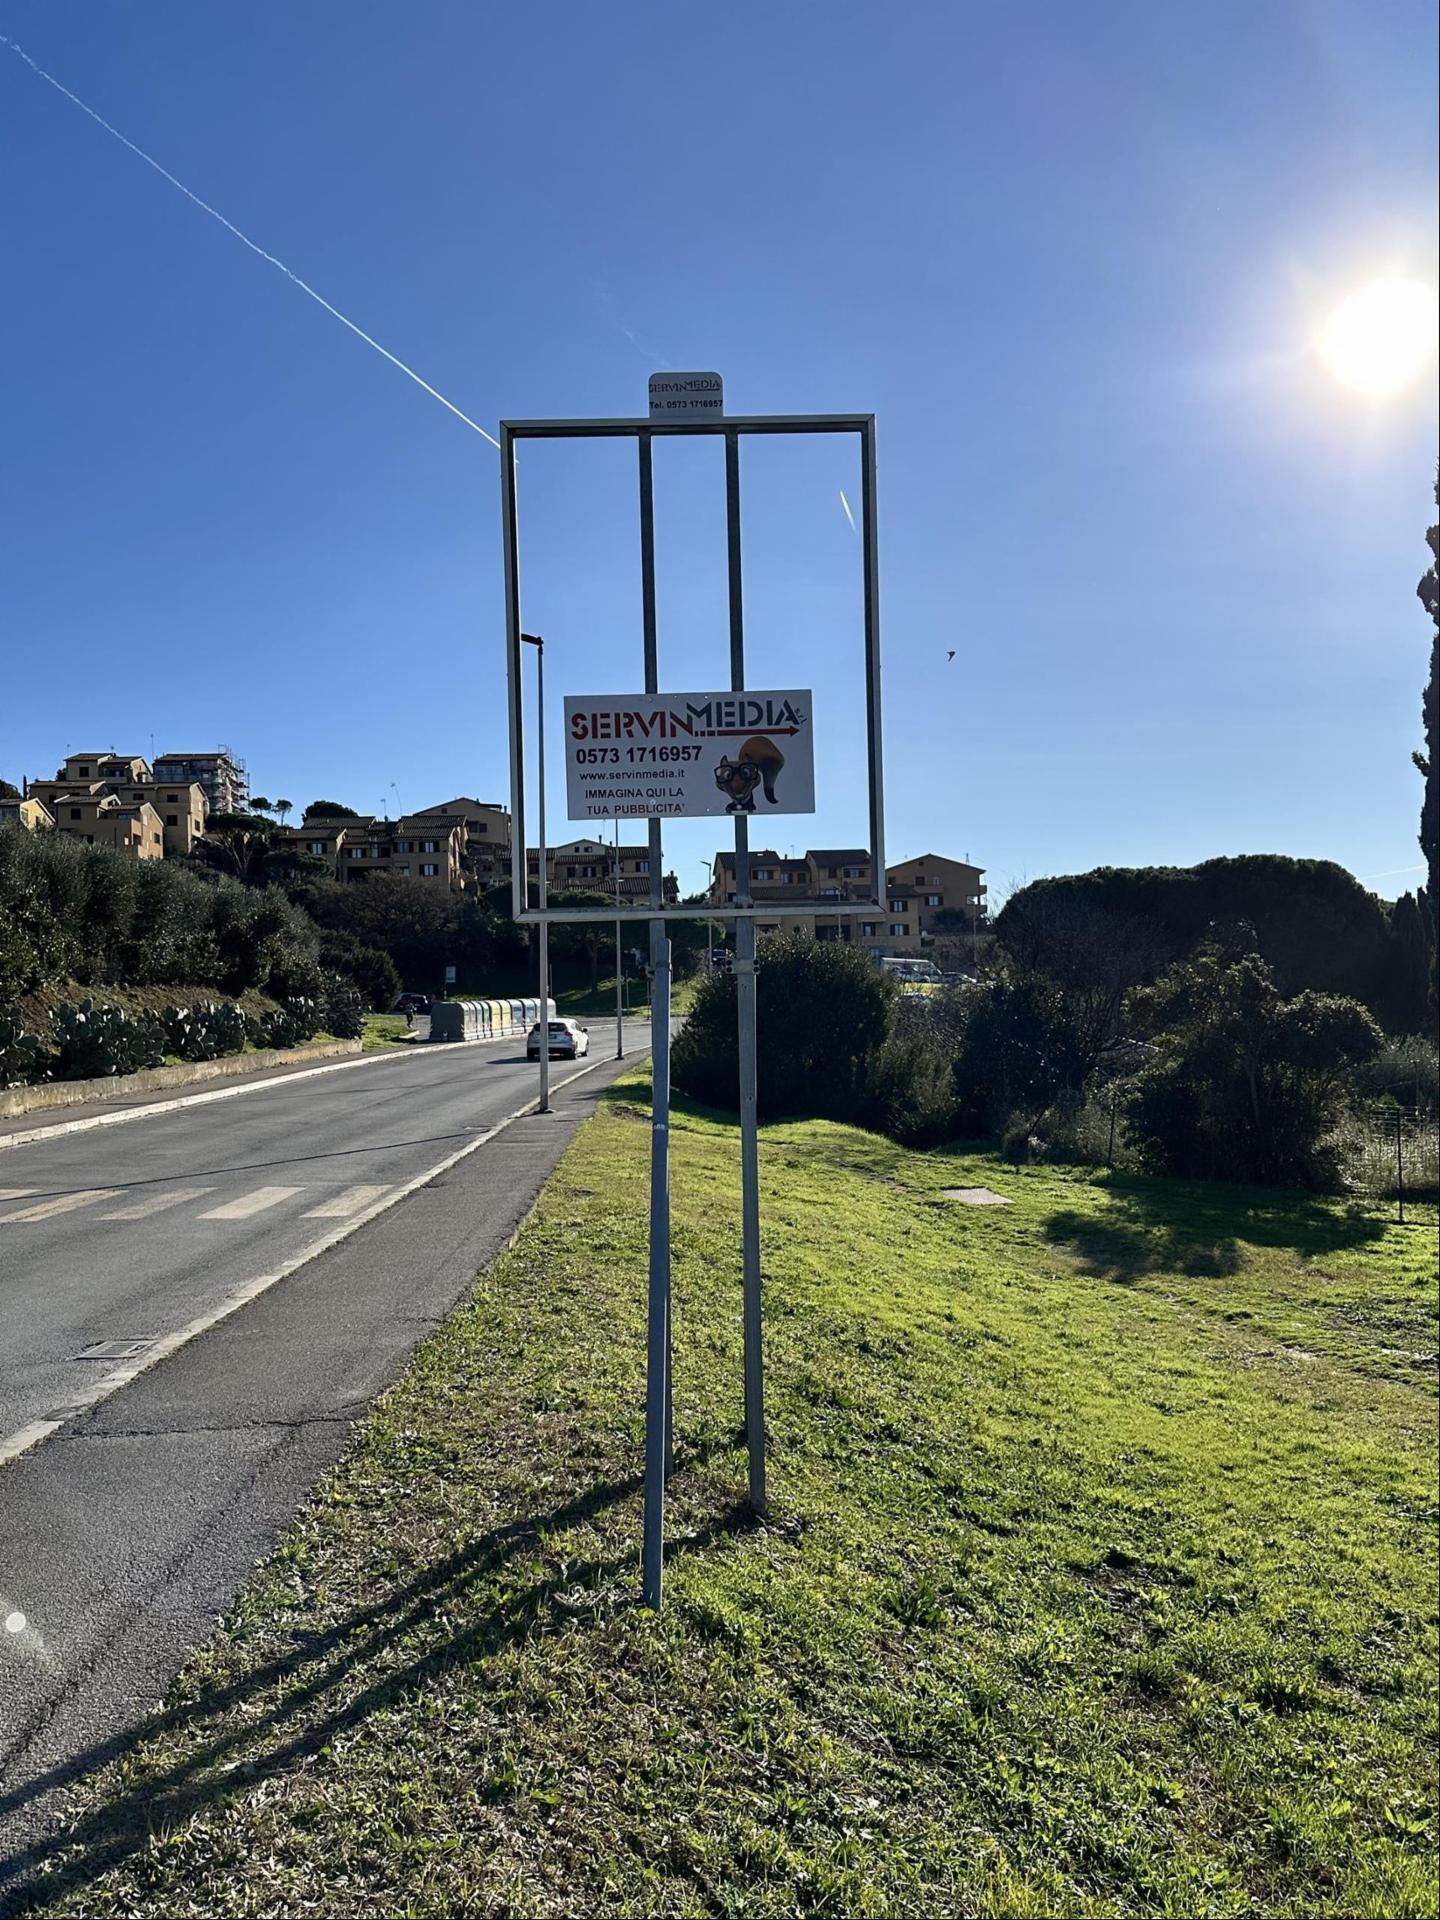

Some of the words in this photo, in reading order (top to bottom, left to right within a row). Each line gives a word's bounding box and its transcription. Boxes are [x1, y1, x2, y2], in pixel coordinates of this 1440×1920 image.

[650, 401, 664, 409] Tel.
[667, 400, 687, 409] 0573
[689, 399, 723, 408] 1716957
[576, 748, 620, 764] 0573
[626, 745, 703, 763] 1716957
[580, 768, 685, 781] www.servinmedia.it
[585, 787, 643, 799] IMMAGINA
[646, 787, 666, 798] QUI
[669, 787, 684, 797] LA
[586, 805, 610, 815] TUA
